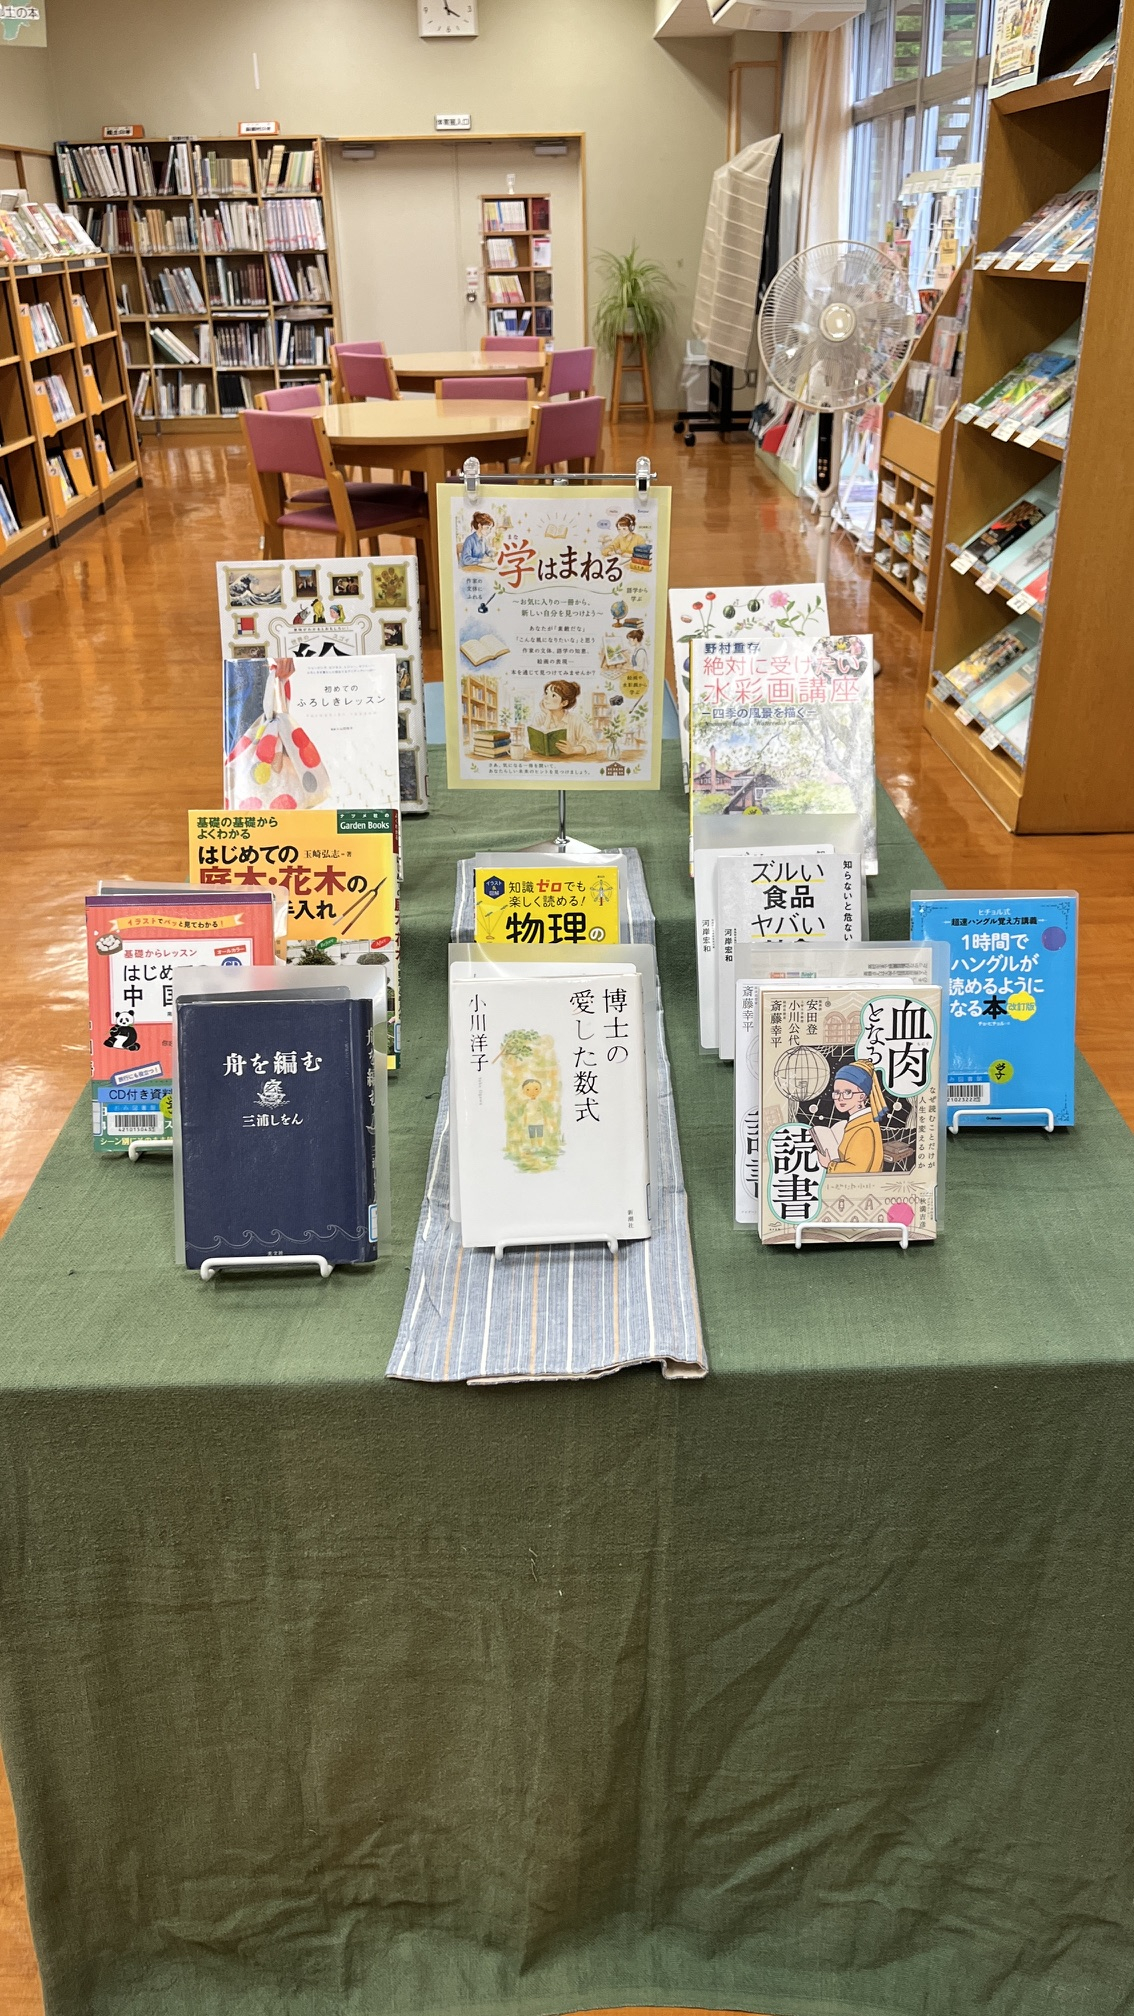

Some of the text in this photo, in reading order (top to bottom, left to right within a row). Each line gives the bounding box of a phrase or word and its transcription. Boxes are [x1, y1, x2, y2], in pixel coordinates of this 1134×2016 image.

[497, 539, 623, 588] 学はまねる
[703, 656, 860, 676] 絶対に受けたい
[297, 695, 386, 707] ふろしきレッスン
[324, 685, 359, 693] 初めての
[703, 677, 860, 705] 水彩画講座
[197, 816, 279, 828] 基礎の基礎から
[340, 821, 390, 830] Garden Books
[197, 829, 251, 840] よくわかる
[198, 845, 299, 865] はじめての
[751, 861, 825, 884] ズルい
[509, 879, 586, 893] 知識ゼロでも
[763, 885, 815, 910] 食品
[287, 900, 336, 920] 入れ
[843, 861, 853, 942] 知らないと危ない
[978, 908, 1011, 916] ヒチョル式
[506, 912, 606, 944] 物理の
[751, 914, 826, 938] ヤバい
[951, 917, 1037, 926] 超速ハングル覚え方講義
[724, 928, 733, 963] 河岸宏和
[961, 932, 1030, 951] 1時間で
[124, 949, 198, 959] 基礎からレッスン
[951, 953, 1040, 974] ハングルが
[949, 977, 1045, 996] 読めるように
[806, 999, 818, 1035] 安田登
[950, 994, 1008, 1020] なる本
[1008, 1003, 1035, 1011] 改訂版
[469, 994, 489, 1072] 小川洋子
[602, 988, 629, 1064] 博士の
[789, 1000, 800, 1046] 小川公代
[865, 1003, 885, 1065] となる
[570, 989, 600, 1122] 愛した数式
[885, 999, 932, 1089] 血肉
[223, 1051, 323, 1076] 舟を編む
[242, 1113, 303, 1127] 三浦しをん
[917, 1096, 927, 1168] 人生を変えるのか
[928, 1087, 937, 1168] なぜ読むことだけが
[772, 1128, 820, 1221] 読書
